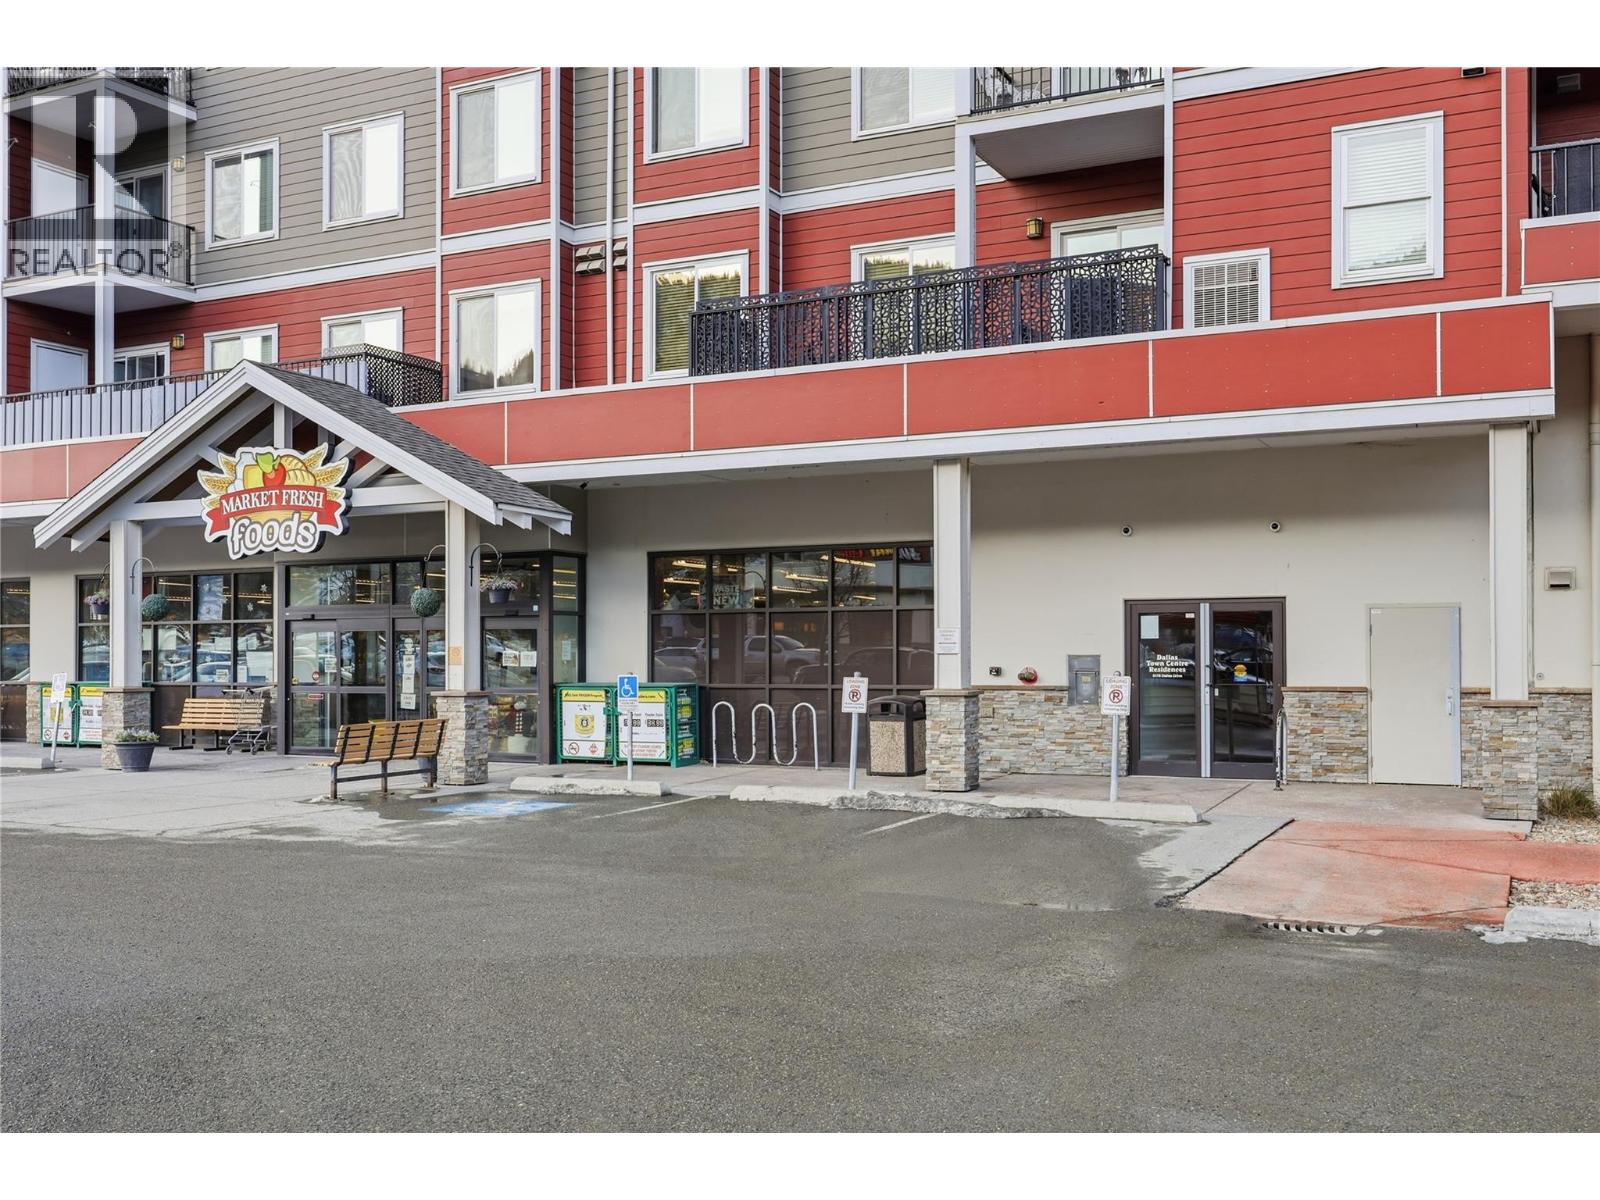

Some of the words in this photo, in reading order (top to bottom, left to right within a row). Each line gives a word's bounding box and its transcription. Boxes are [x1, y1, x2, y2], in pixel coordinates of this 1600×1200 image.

[221, 489, 280, 515] MARKET
[282, 489, 325, 508] FRESH
[231, 511, 318, 555] foods
[713, 596, 740, 606] NEW
